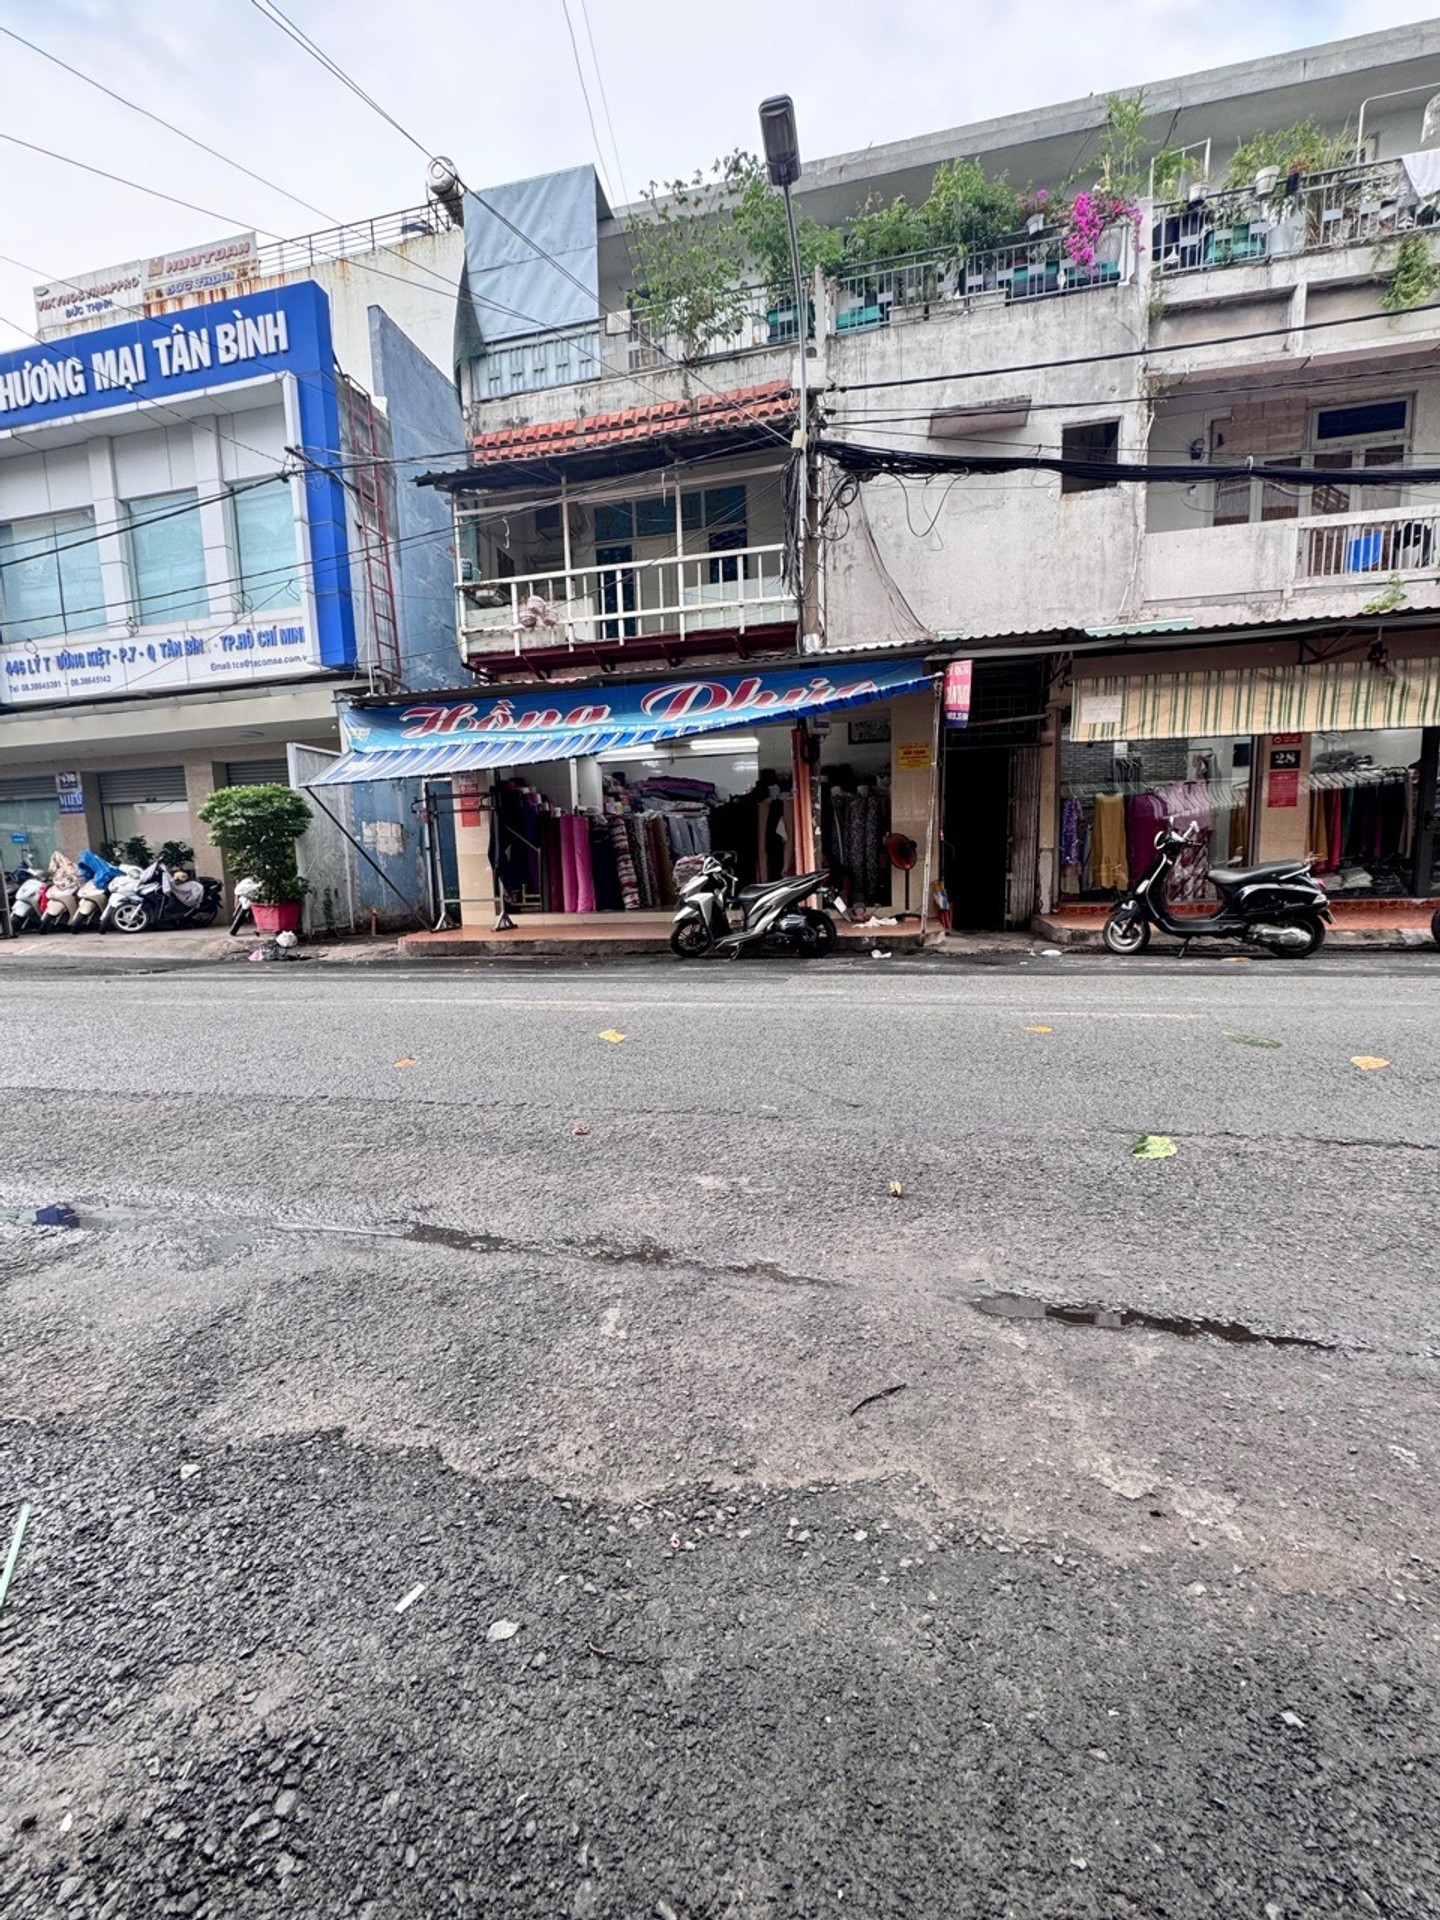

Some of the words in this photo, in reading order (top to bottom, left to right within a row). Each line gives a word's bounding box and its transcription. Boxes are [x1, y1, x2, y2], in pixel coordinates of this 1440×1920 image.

[91, 343, 147, 392] MẠI
[152, 323, 212, 376] TÂN
[215, 309, 288, 364] BÌNH
[5, 659, 26, 676] 446
[27, 653, 40, 674] LÝ
[87, 646, 111, 669] KIỆT
[159, 637, 183, 659] TÂN
[256, 625, 278, 648] CHÍ
[1275, 751, 1296, 764] 28
